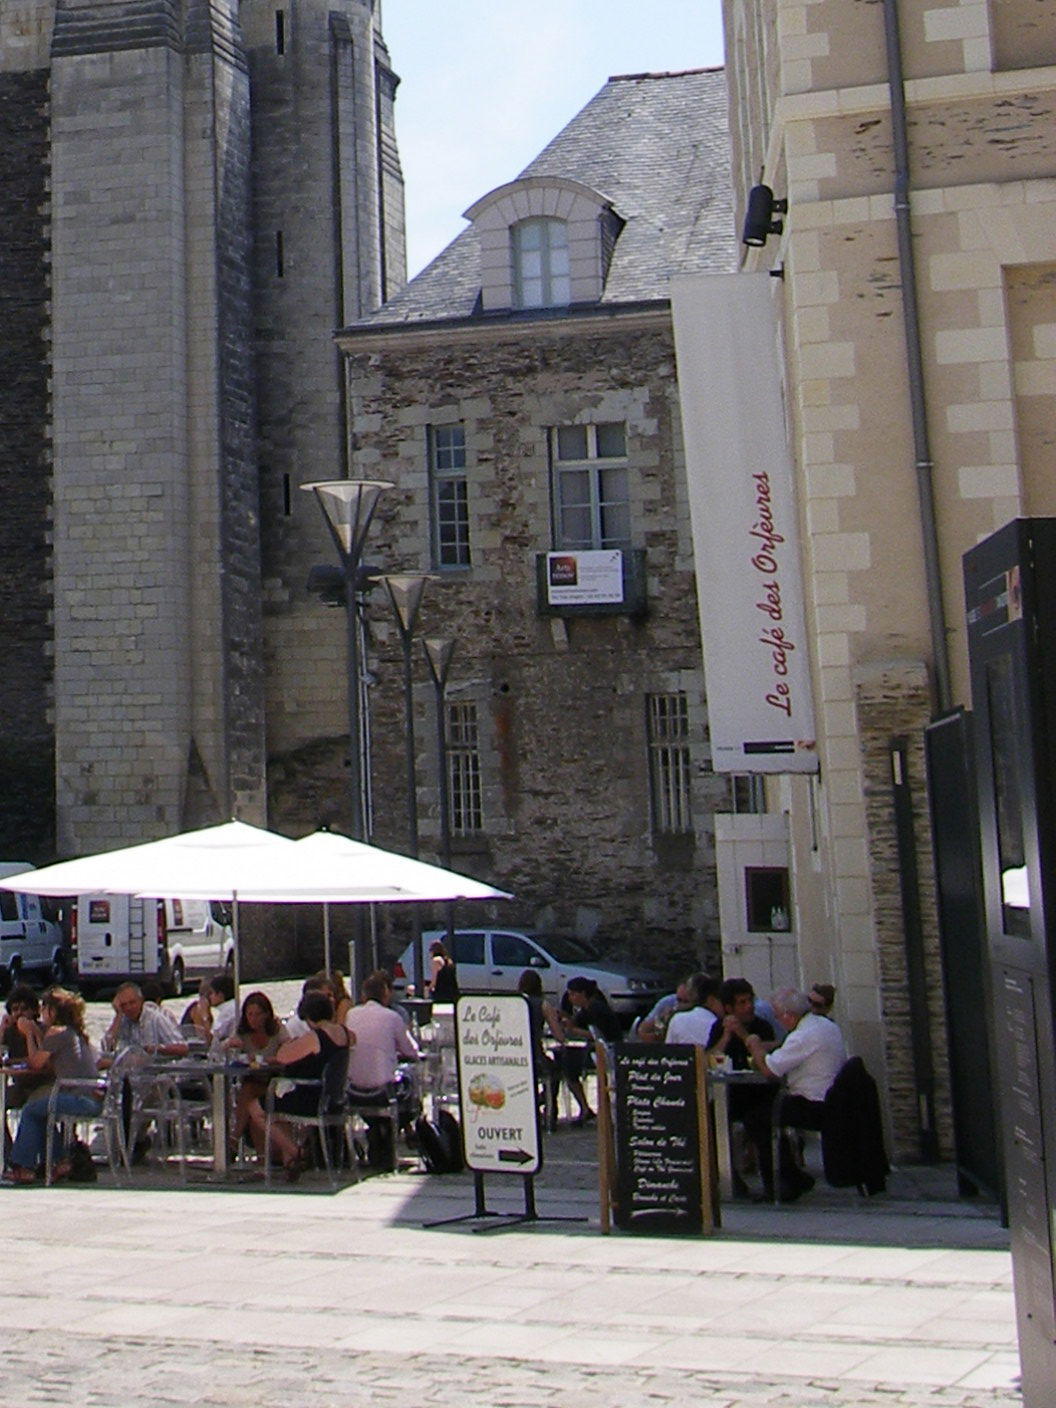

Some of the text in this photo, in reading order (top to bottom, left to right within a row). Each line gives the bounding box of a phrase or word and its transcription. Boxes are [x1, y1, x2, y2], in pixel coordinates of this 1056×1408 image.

[749, 471, 785, 574] Orfèvres
[756, 581, 783, 621] des
[759, 627, 795, 675] café
[766, 682, 792, 717] Le
[462, 1005, 502, 1028] Le Café
[462, 1029, 479, 1045] des
[464, 1055, 529, 1068] GLACES ARTISANALES
[628, 1070, 649, 1082] Plat
[663, 1071, 682, 1085] Jour
[652, 1095, 686, 1109] Chauds
[477, 1127, 524, 1141] OUVERT
[629, 1135, 687, 1147] Salon de Thé
[637, 1177, 679, 1189] Dimanche
